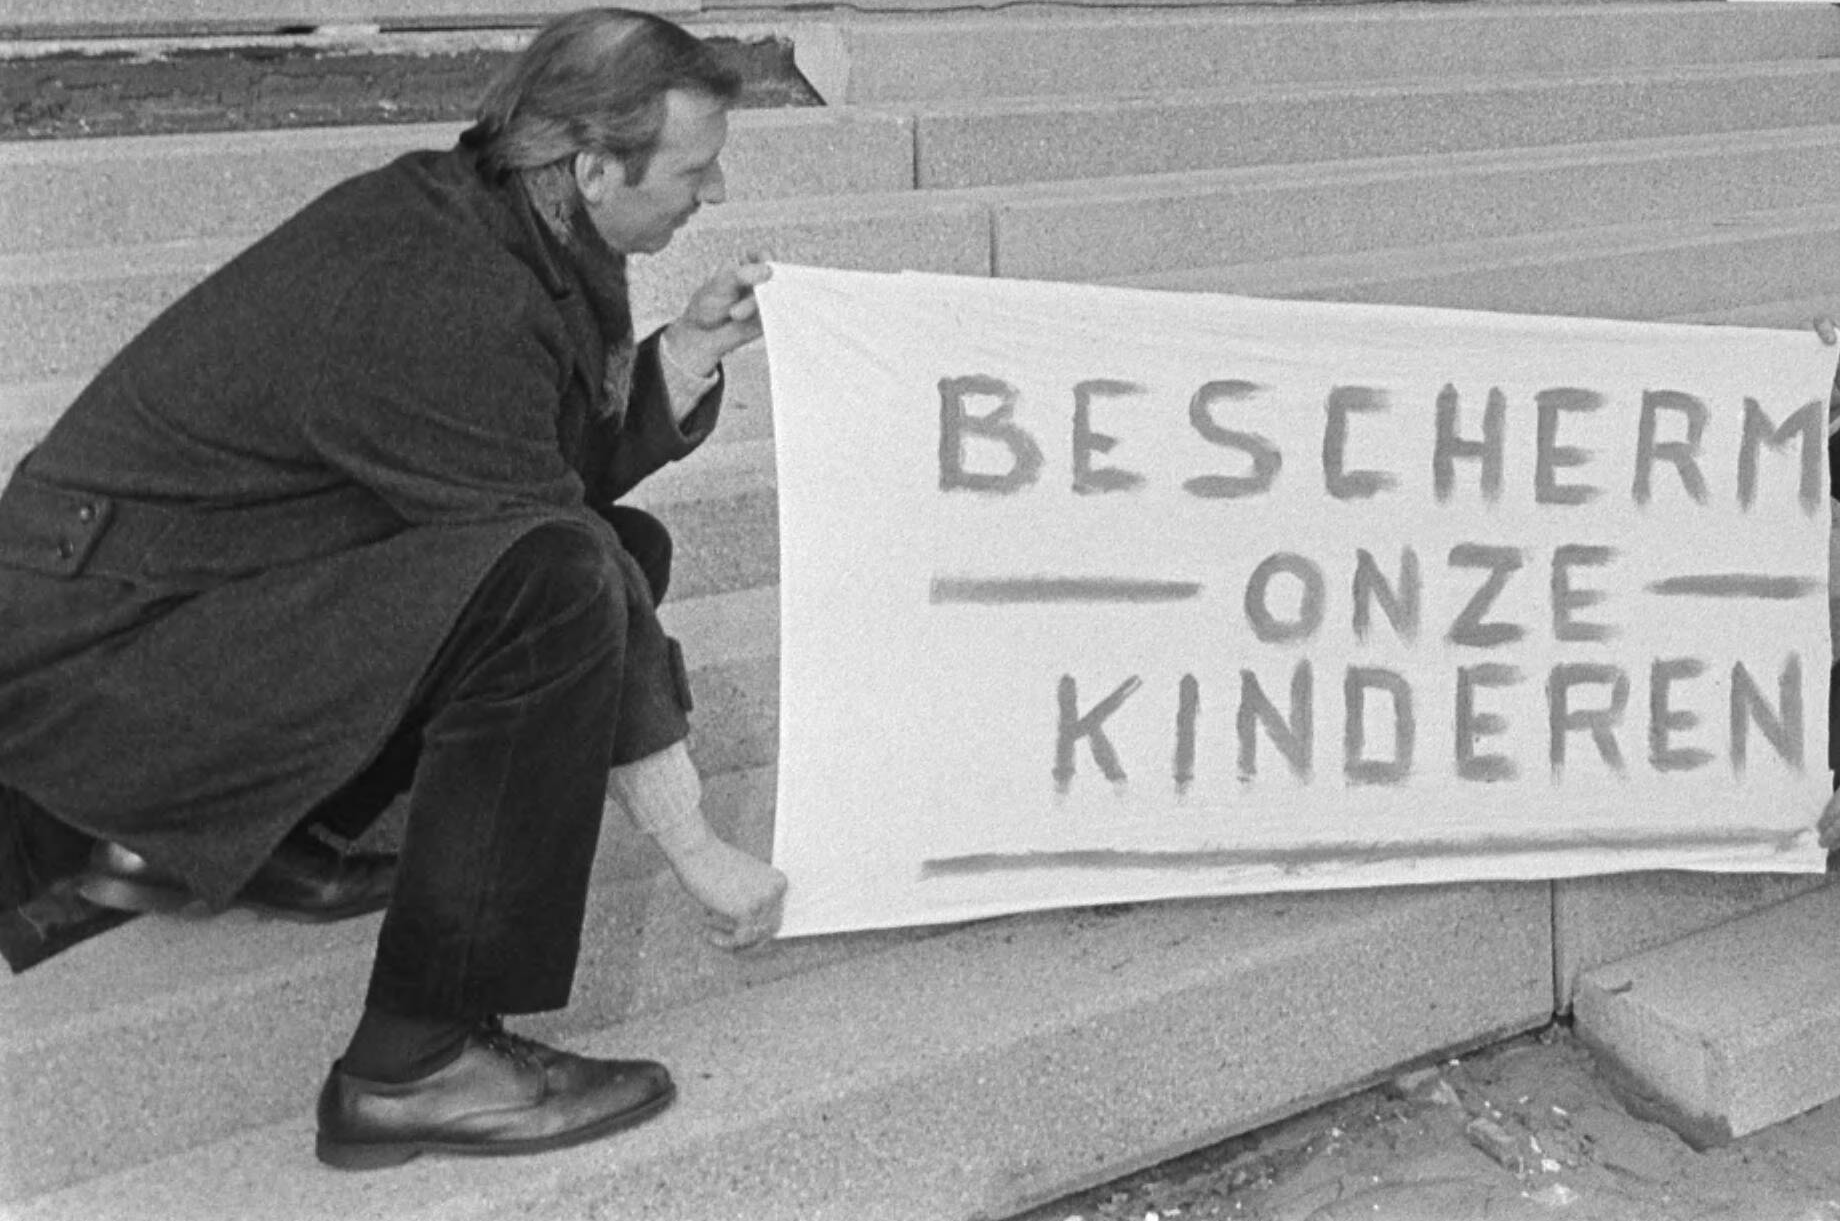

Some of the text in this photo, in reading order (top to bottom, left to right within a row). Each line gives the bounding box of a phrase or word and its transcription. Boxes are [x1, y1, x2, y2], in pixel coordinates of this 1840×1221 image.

[937, 374, 1822, 516] BESCHERM
[1244, 543, 1622, 646] ONZE
[1053, 655, 1803, 796] KINDEREN
